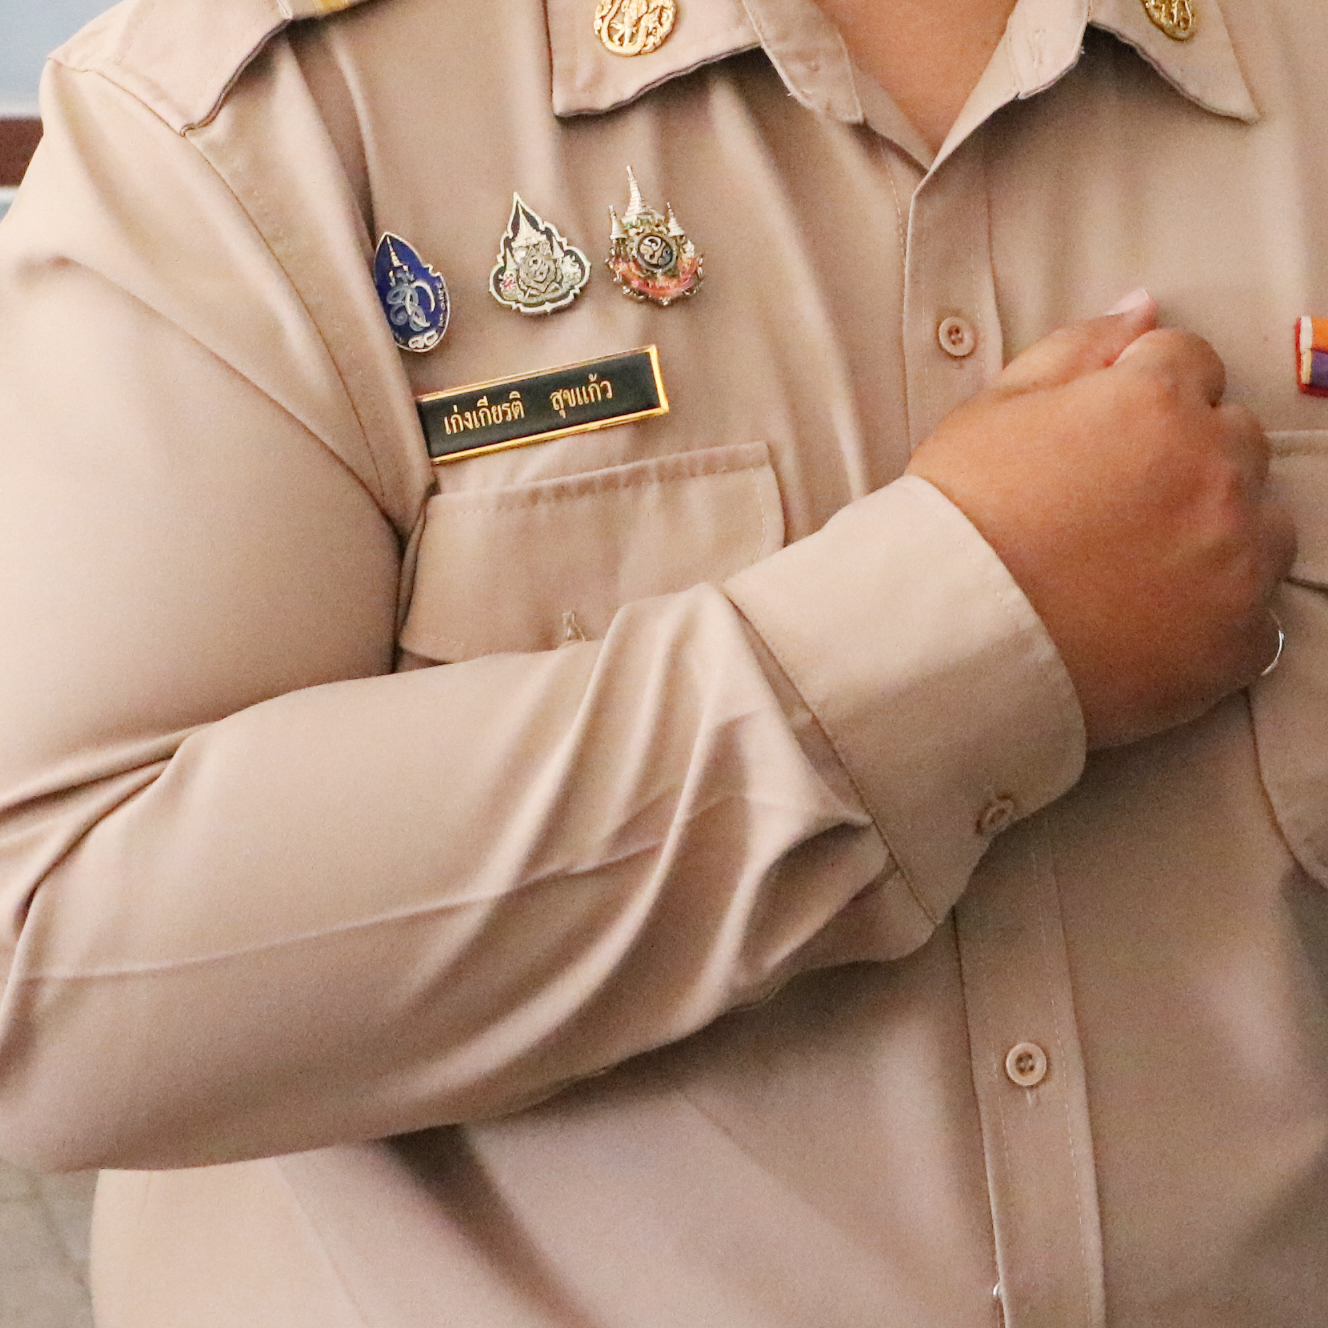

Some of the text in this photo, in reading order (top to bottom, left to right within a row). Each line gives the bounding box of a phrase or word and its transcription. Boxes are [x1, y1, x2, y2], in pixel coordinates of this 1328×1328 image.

[443, 373, 614, 436] เก่งเกียรติ สุขแก้ว
